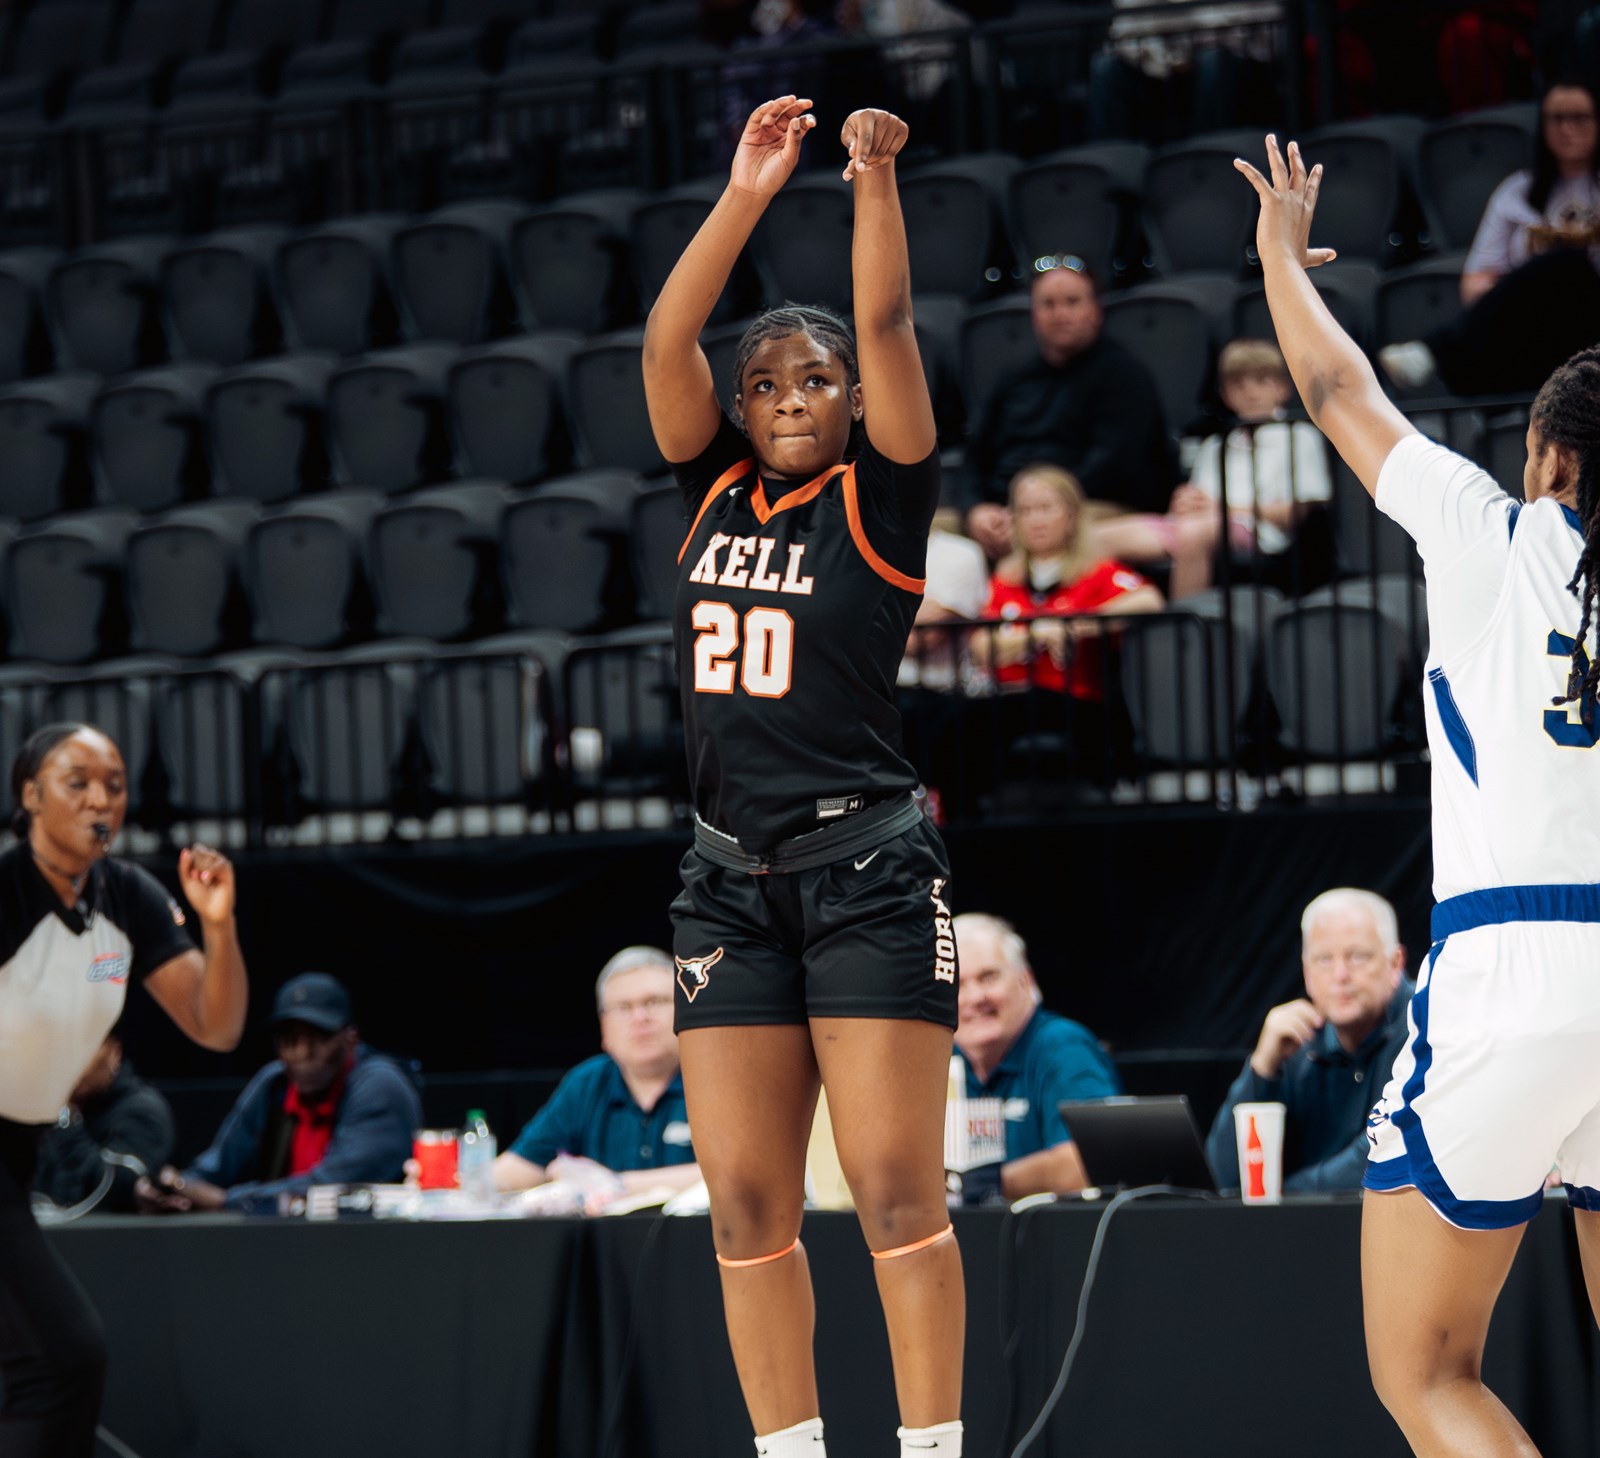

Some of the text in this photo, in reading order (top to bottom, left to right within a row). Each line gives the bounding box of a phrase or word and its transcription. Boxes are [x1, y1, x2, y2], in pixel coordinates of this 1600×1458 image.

[689, 531, 815, 595] KELL
[691, 600, 795, 699] 20
[849, 799, 859, 810] M
